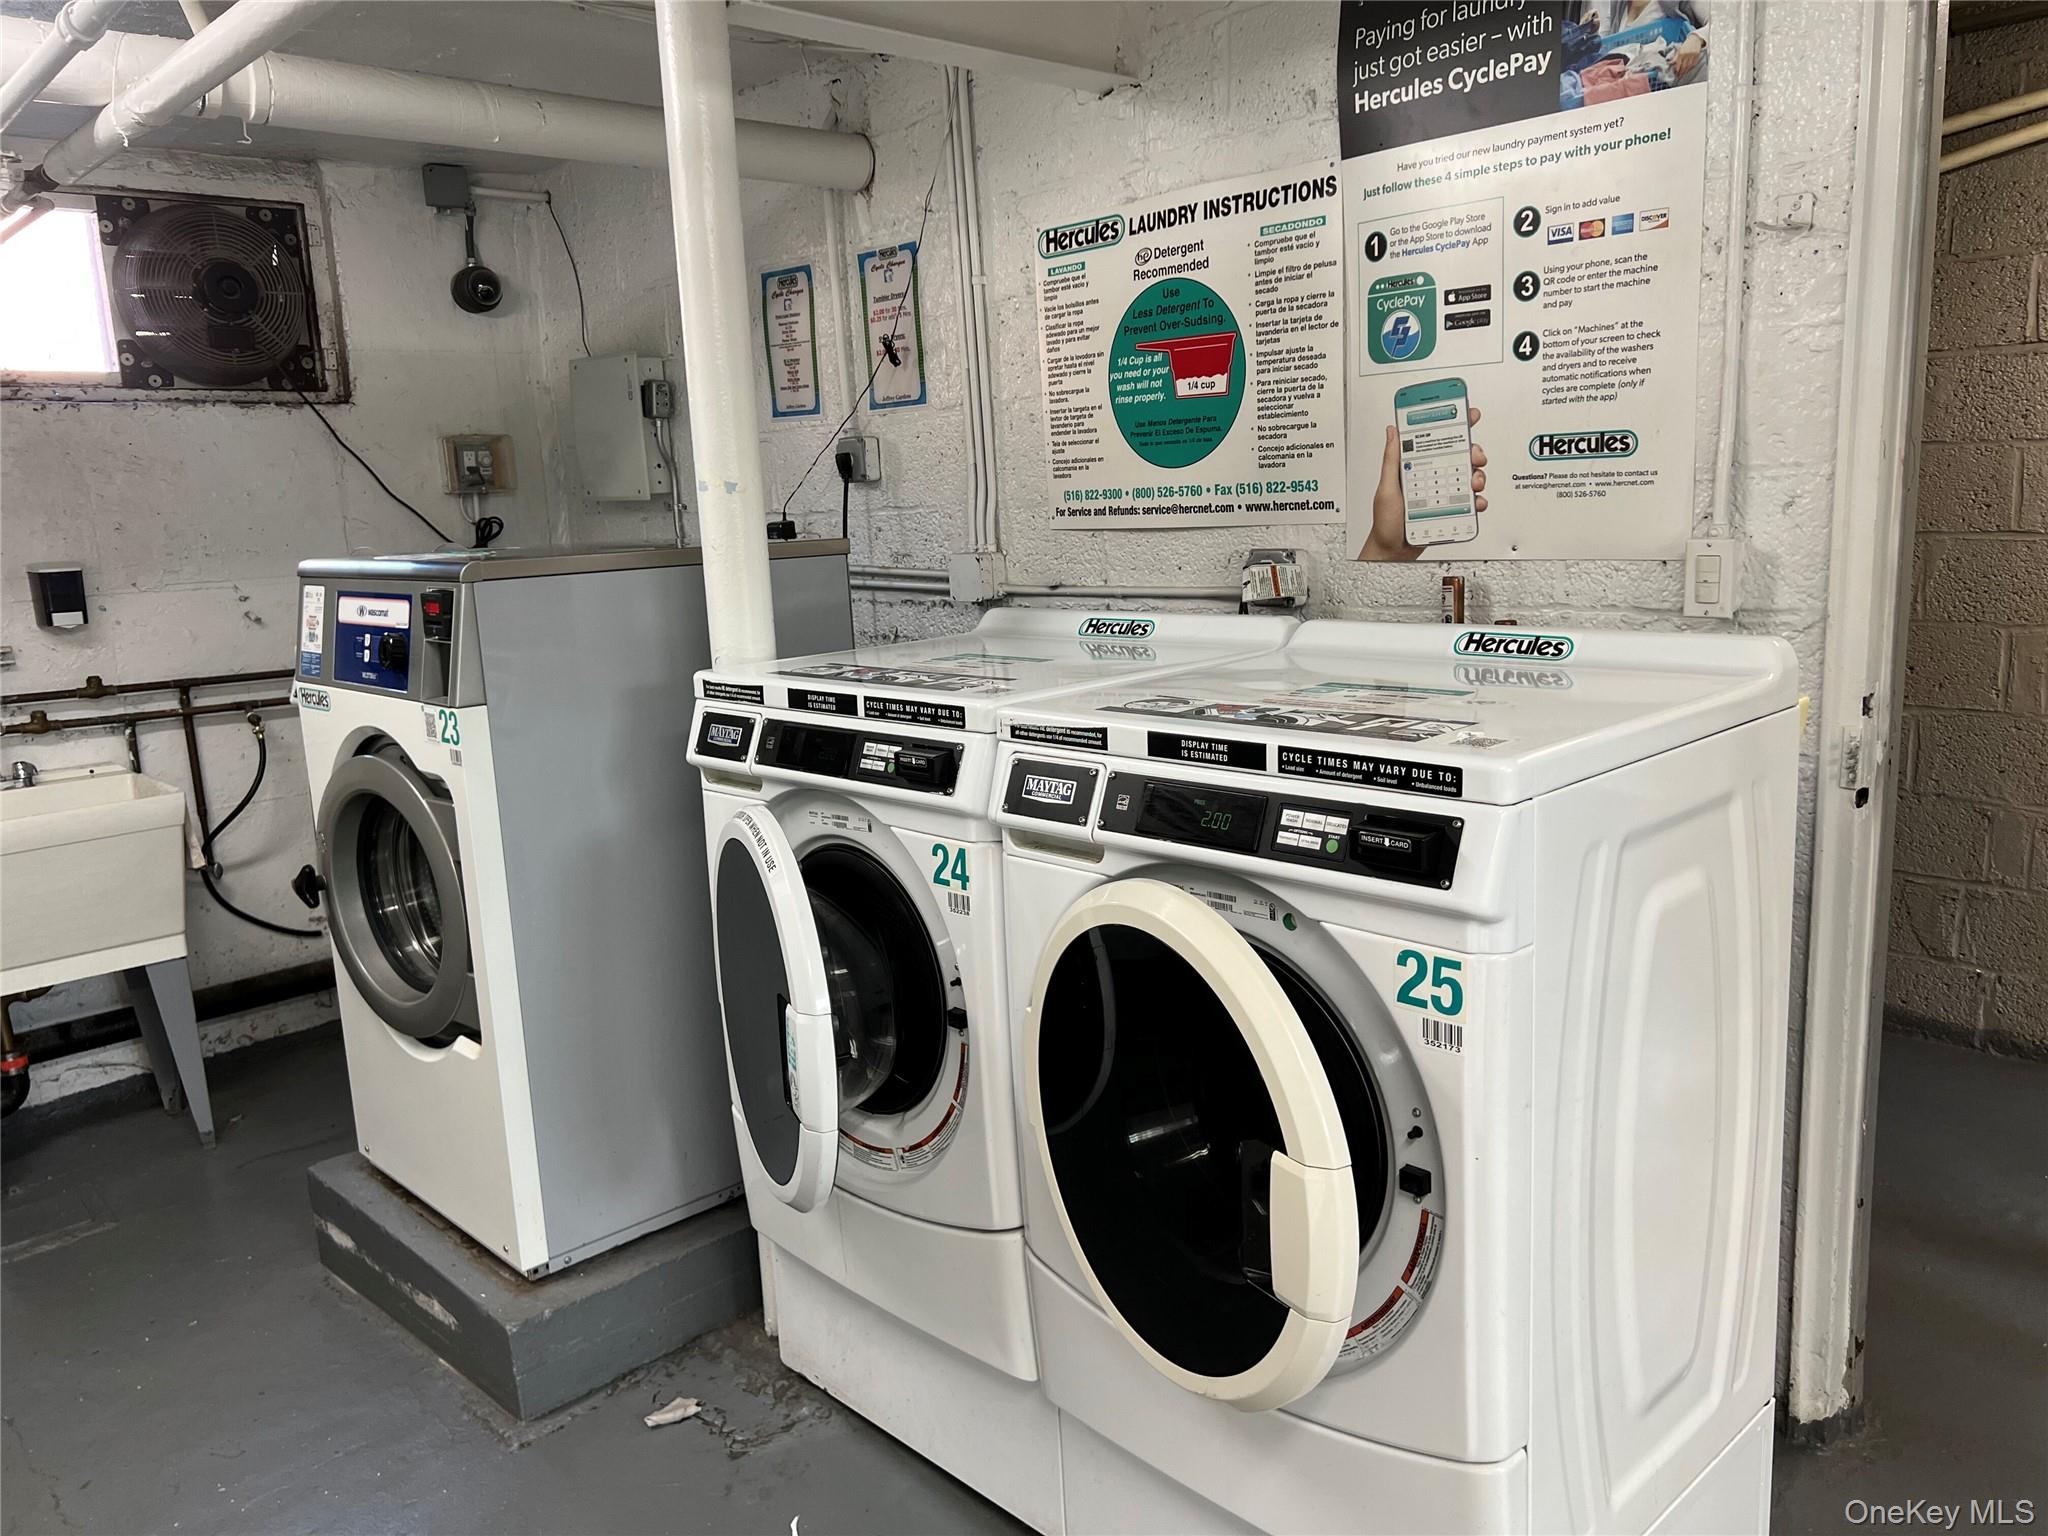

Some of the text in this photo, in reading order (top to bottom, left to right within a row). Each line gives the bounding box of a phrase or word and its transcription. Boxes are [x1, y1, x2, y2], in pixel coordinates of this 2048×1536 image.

[1356, 19, 1415, 49] Paying
[1421, 8, 1447, 30] for
[1353, 11, 1552, 87] just got easier with
[1355, 51, 1552, 114] Hercules CyclePay
[1397, 117, 1624, 172] Have you tried our new laundry payment system yet?
[1363, 128, 1671, 200] Just follow these 4 simple steps to pay with your phone!
[1045, 175, 1337, 253] Hercules LAUNDRY INSTRUCTIONS
[1545, 195, 1620, 215] Sign in to add value
[1262, 218, 1323, 235] SECADONDO
[1521, 210, 1533, 232] 2
[1551, 226, 1572, 237] VISA
[1154, 240, 1204, 259] Detergent
[1370, 236, 1378, 256] 1
[1390, 237, 1488, 259] the Hercules CyclePay App
[1051, 264, 1082, 275] LAVANDO
[1133, 257, 1209, 281] Recommended
[1163, 288, 1180, 298] Use
[1521, 276, 1533, 296] 3
[1133, 298, 1214, 319] Less Detergent To
[1377, 295, 1425, 312] CyclePay
[1124, 315, 1225, 336] Prevent Over-Sudsing.
[1543, 329, 1561, 337] Click
[1621, 321, 1629, 329] at
[1631, 320, 1643, 328] the
[1519, 336, 1531, 355] 4
[1117, 356, 1127, 366] 1/4
[1129, 355, 1143, 366] Cup
[1154, 353, 1162, 361] all
[1110, 366, 1169, 381] you need or your
[1117, 379, 1162, 391] wash will not
[1188, 381, 1215, 390] 1/4 cup
[1116, 391, 1166, 404] rinse properly.
[1268, 422, 1309, 432] sobrecargue
[1539, 432, 1630, 455] Hercules
[1512, 473, 1547, 481] Questions?
[1064, 480, 1318, 503] (516) 822-9300 (800) 526-5760 Fax (516) 822-9543
[1556, 490, 1573, 498] (800)
[1056, 500, 1334, 516] For Service and Refunds: service@hercnet.com www.hercnet.com
[1085, 619, 1149, 636] Hercules
[1464, 632, 1565, 656] Hercules
[300, 689, 329, 708] Hercules
[808, 694, 824, 702] DISPLAY
[866, 701, 883, 709] CYCLE
[886, 703, 903, 711] TIMES
[439, 710, 460, 745] 23
[711, 726, 739, 739] MAYTAG
[1182, 740, 1228, 752] DISPLAY TIME
[1191, 751, 1228, 761] ESTIMATED
[1283, 752, 1456, 783] CYCLE TIMES MAY VARY DUE TO:
[1342, 771, 1362, 780] detergent
[1027, 778, 1072, 796] MAYTAG
[1416, 781, 1442, 791] Unbalanced
[1032, 791, 1061, 800] COMMERCIAL
[1201, 811, 1232, 830] 2.00
[1361, 835, 1408, 848] INSERT CARD
[756, 835, 776, 872] NOT IN USE
[932, 844, 969, 890] 24
[1396, 949, 1463, 1016] 25
[1425, 1038, 1460, 1053] 352173
